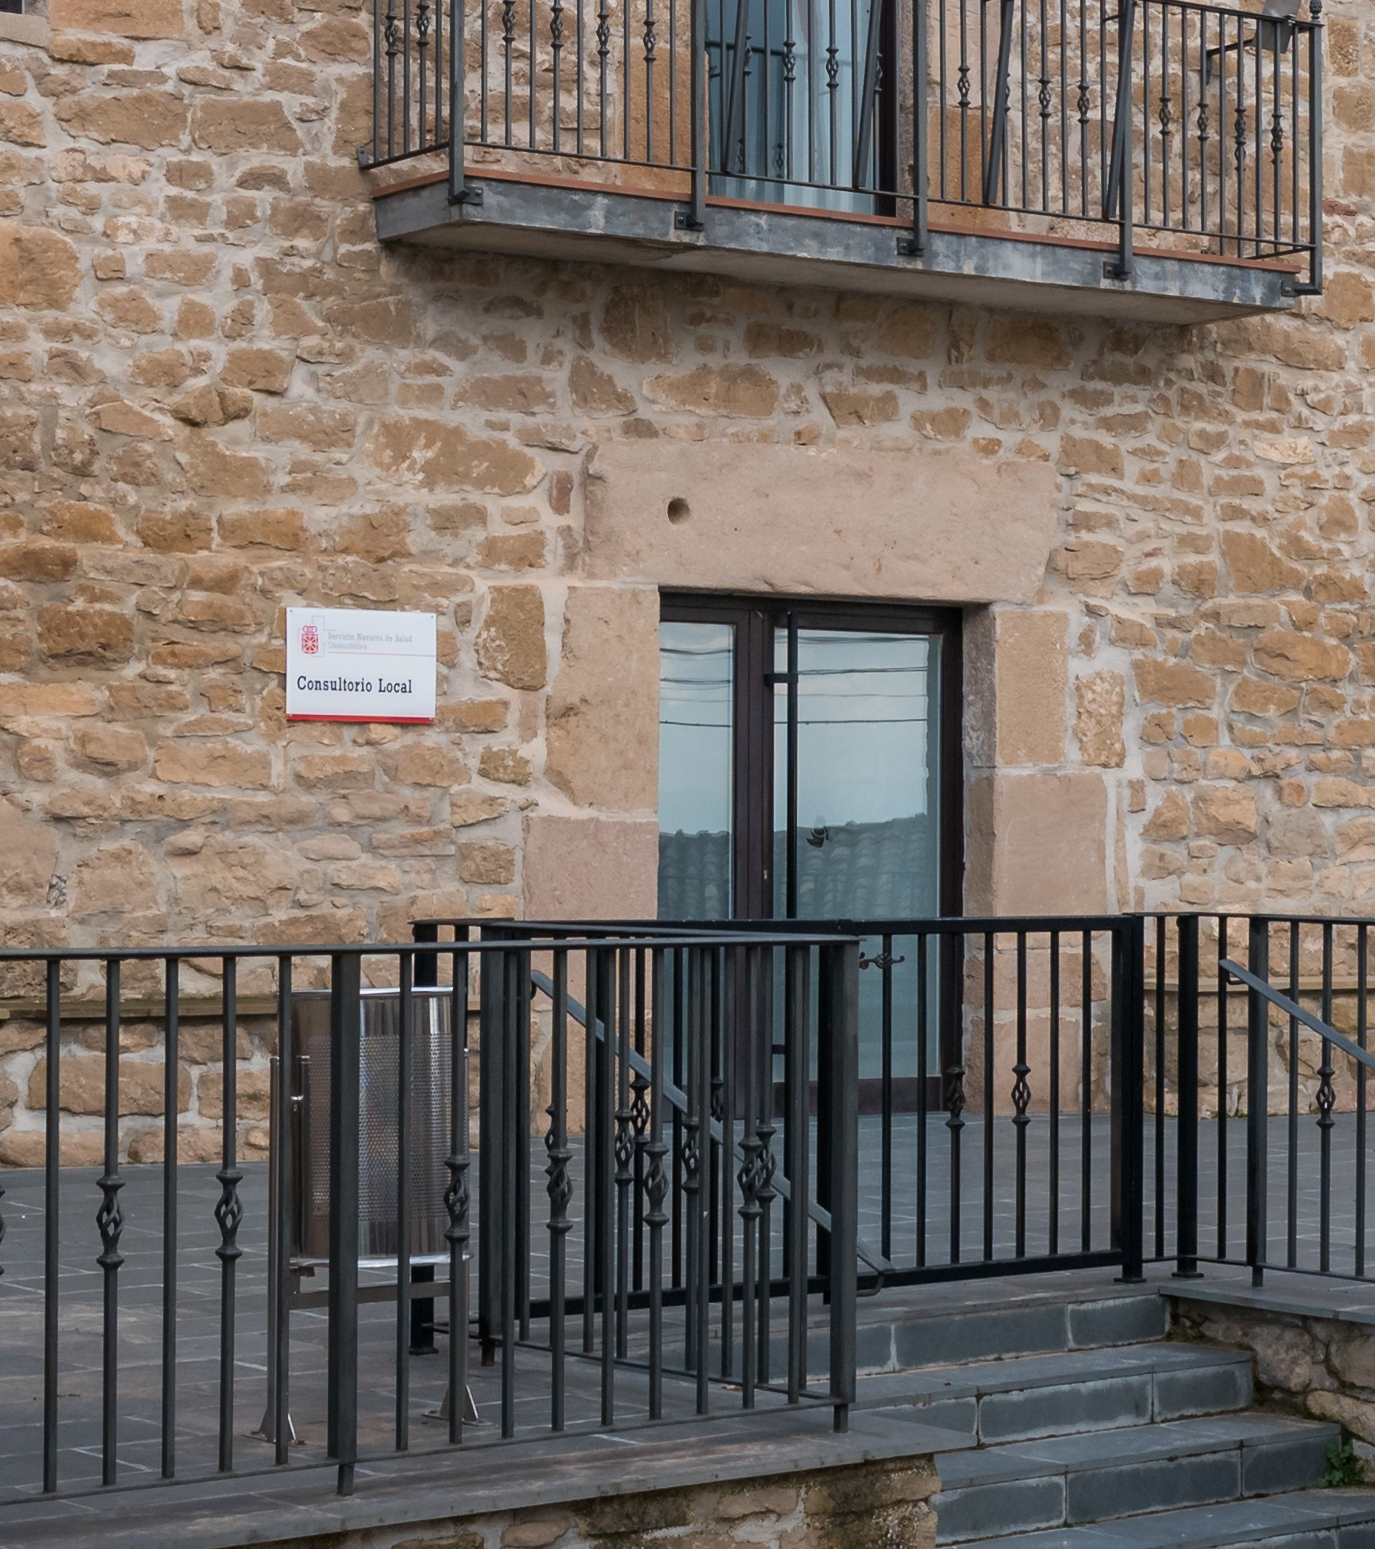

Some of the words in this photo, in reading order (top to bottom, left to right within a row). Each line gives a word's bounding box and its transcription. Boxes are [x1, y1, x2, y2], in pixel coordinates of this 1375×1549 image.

[395, 634, 413, 643] Salud
[297, 675, 373, 693] Consultorio
[378, 678, 412, 694] Local
